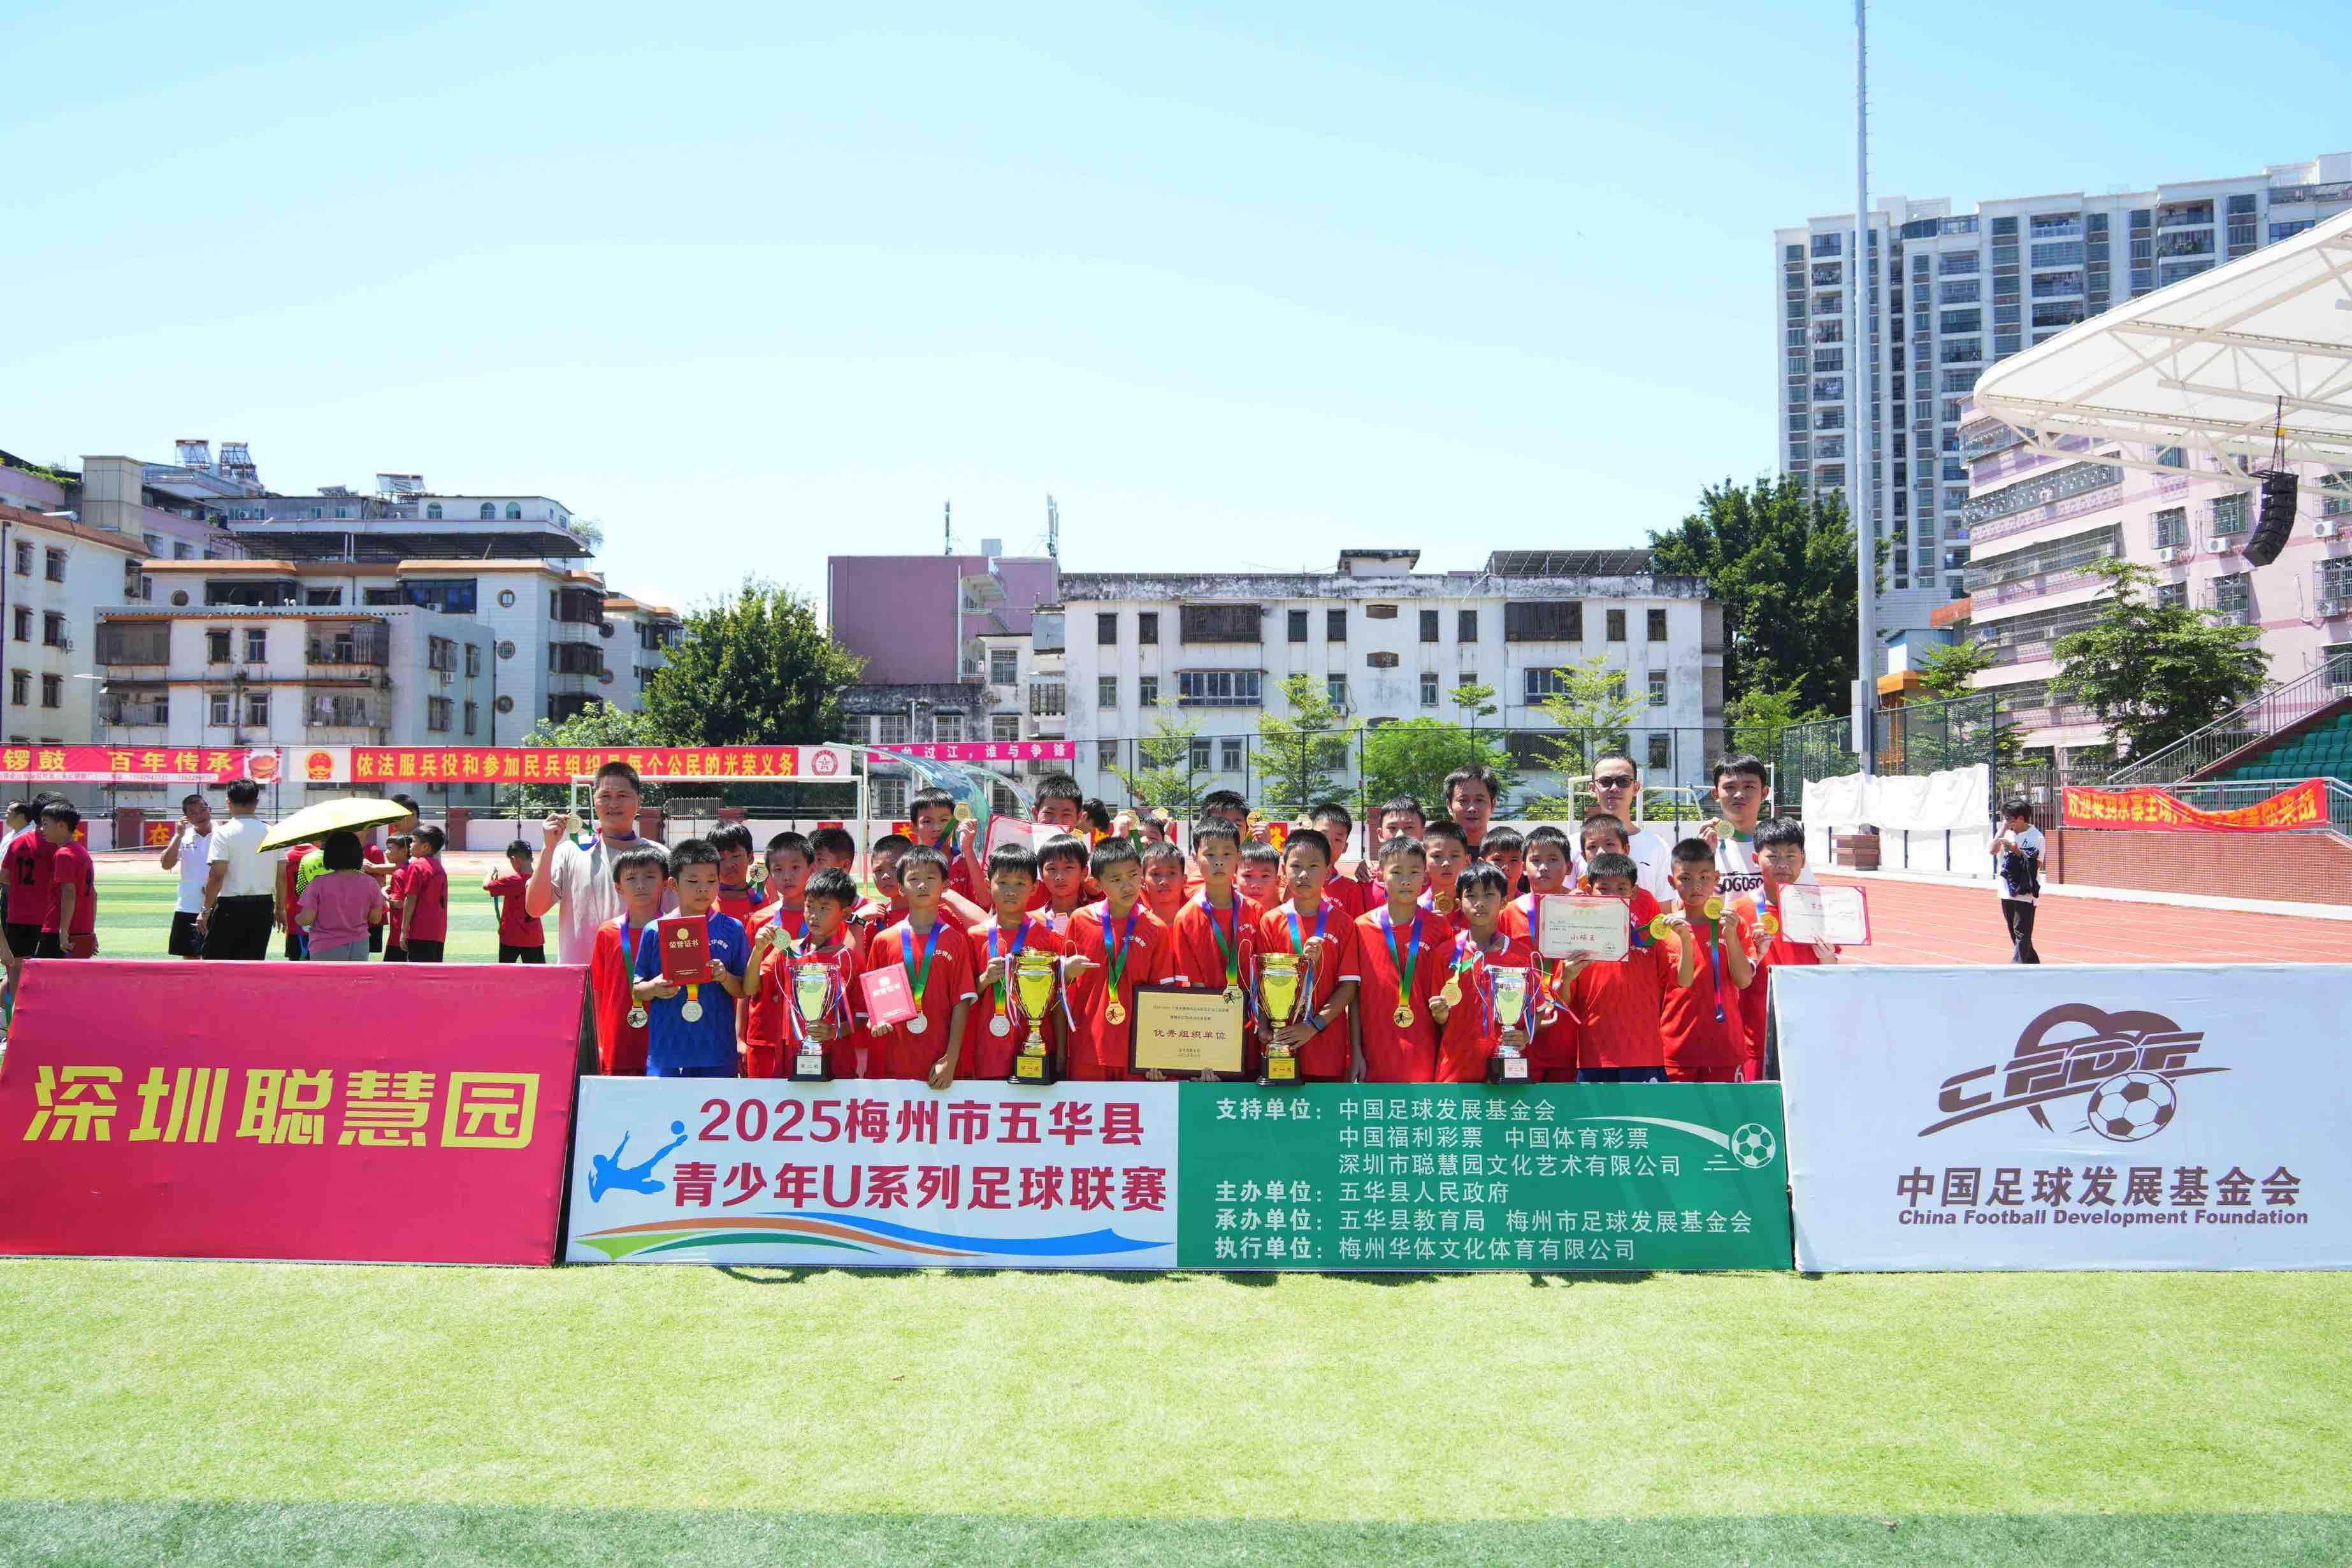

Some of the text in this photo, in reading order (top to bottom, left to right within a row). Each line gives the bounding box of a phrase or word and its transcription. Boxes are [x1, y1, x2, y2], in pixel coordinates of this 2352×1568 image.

[107, 751, 233, 773] 百年传承
[879, 744, 1065, 761] 龙过江，谁与争锋
[17, 858, 36, 886] 12
[1153, 1028, 1227, 1040] 优秀组织单位
[24, 1065, 540, 1149] 深圳聪慧园
[1215, 1097, 1556, 1121] 支持单位： 中国足球发展基金会
[697, 1098, 1145, 1146] 2025梅州市五华县
[1339, 1126, 1649, 1149] 中国福利彩票 中国体育彩票
[1339, 1154, 1680, 1177] 深圳市聪慧园文化艺术有限公司
[672, 1162, 1167, 1212] 青少年U系列足球联赛
[1215, 1180, 1510, 1204] 主办单位： 五华县人民政府
[1896, 1166, 2302, 1207] 中国足球发展基金会
[1215, 1208, 1753, 1234] 承办单位： 五华县教育局 梅州市足球发展基金会
[1898, 1210, 2309, 1228] China Football Development Foundation
[1215, 1236, 1635, 1262] 执行单位： 梅州华体文化体育有限公司
